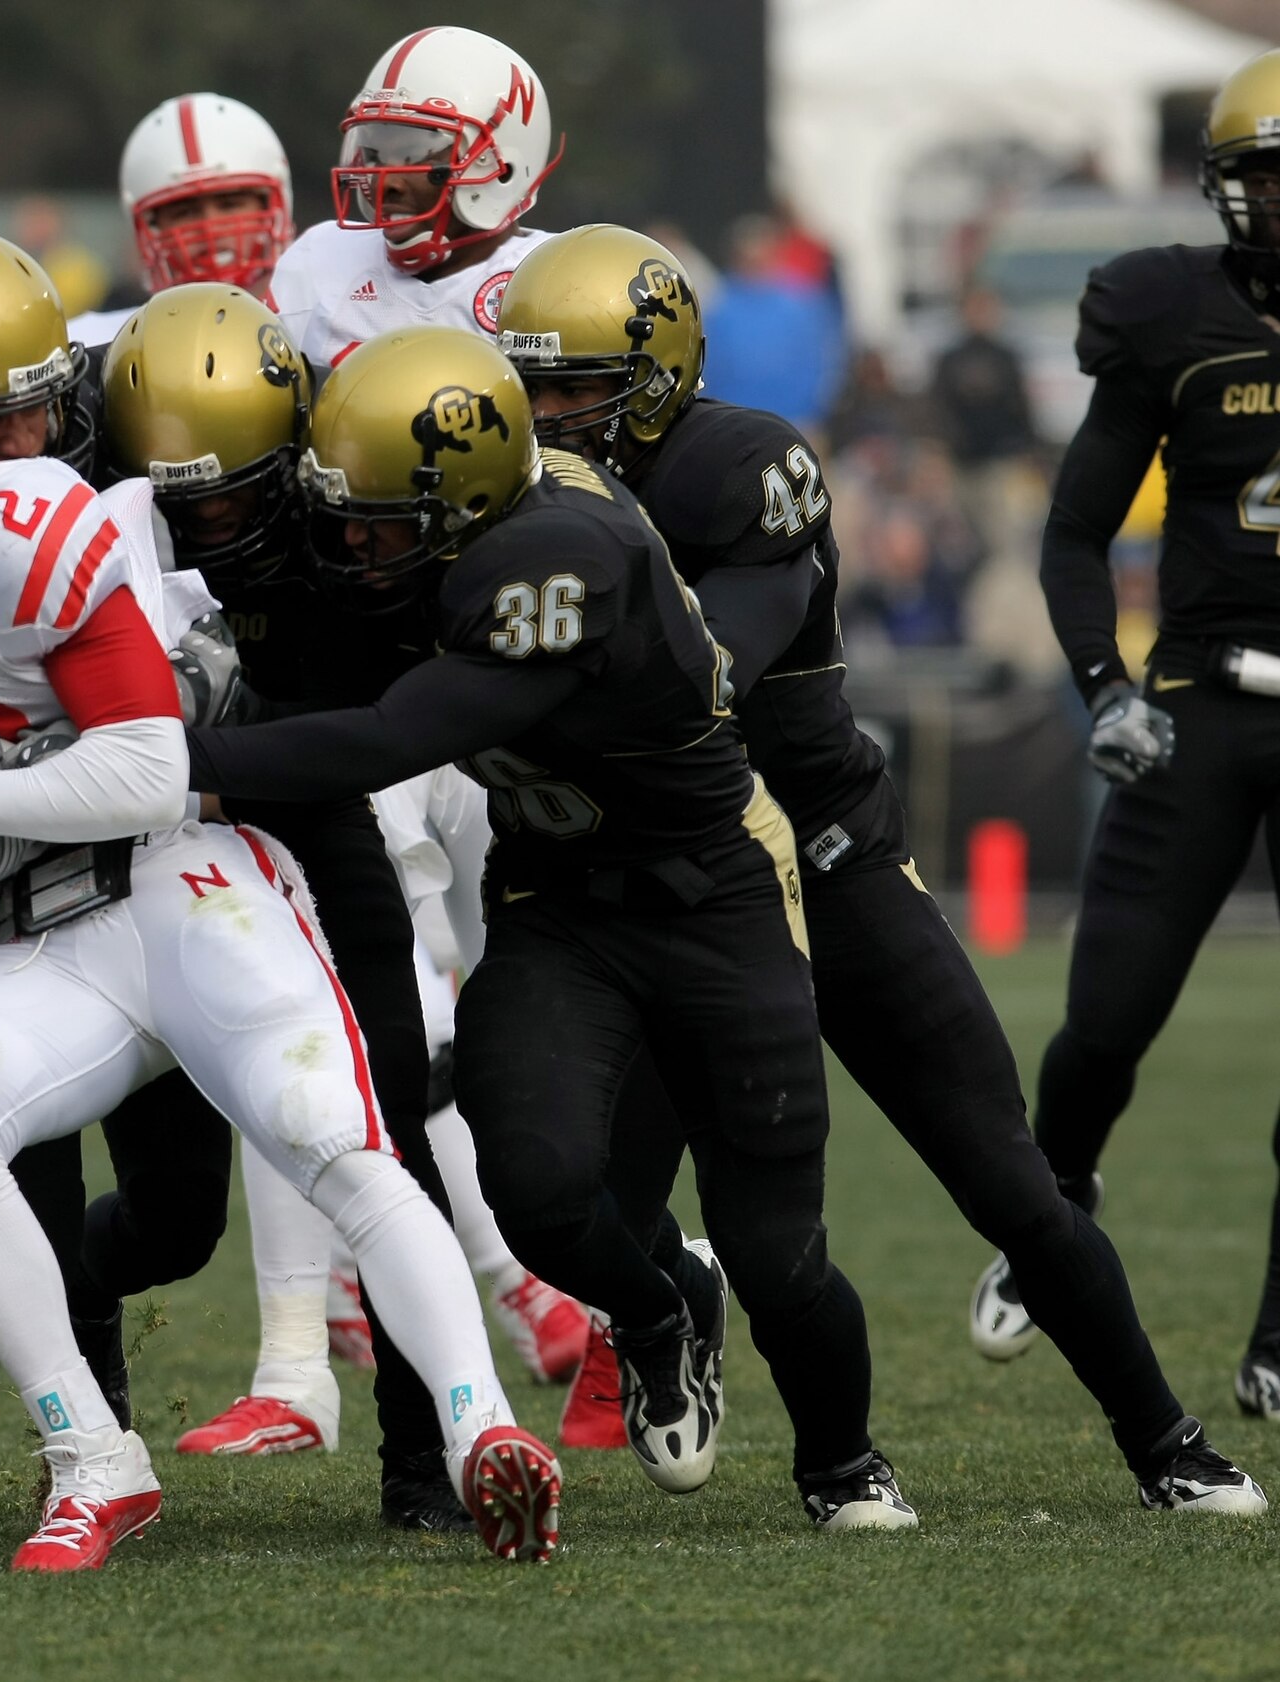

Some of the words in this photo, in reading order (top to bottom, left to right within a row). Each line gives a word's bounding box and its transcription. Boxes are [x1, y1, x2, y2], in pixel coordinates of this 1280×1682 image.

[500, 63, 536, 126] N
[512, 335, 542, 349] BUFFS
[26, 360, 56, 384] BUFFS
[165, 463, 202, 479] BUFFS
[761, 444, 828, 537] 42
[489, 573, 585, 660] 36
[815, 834, 837, 857] 42
[179, 862, 232, 898] N
